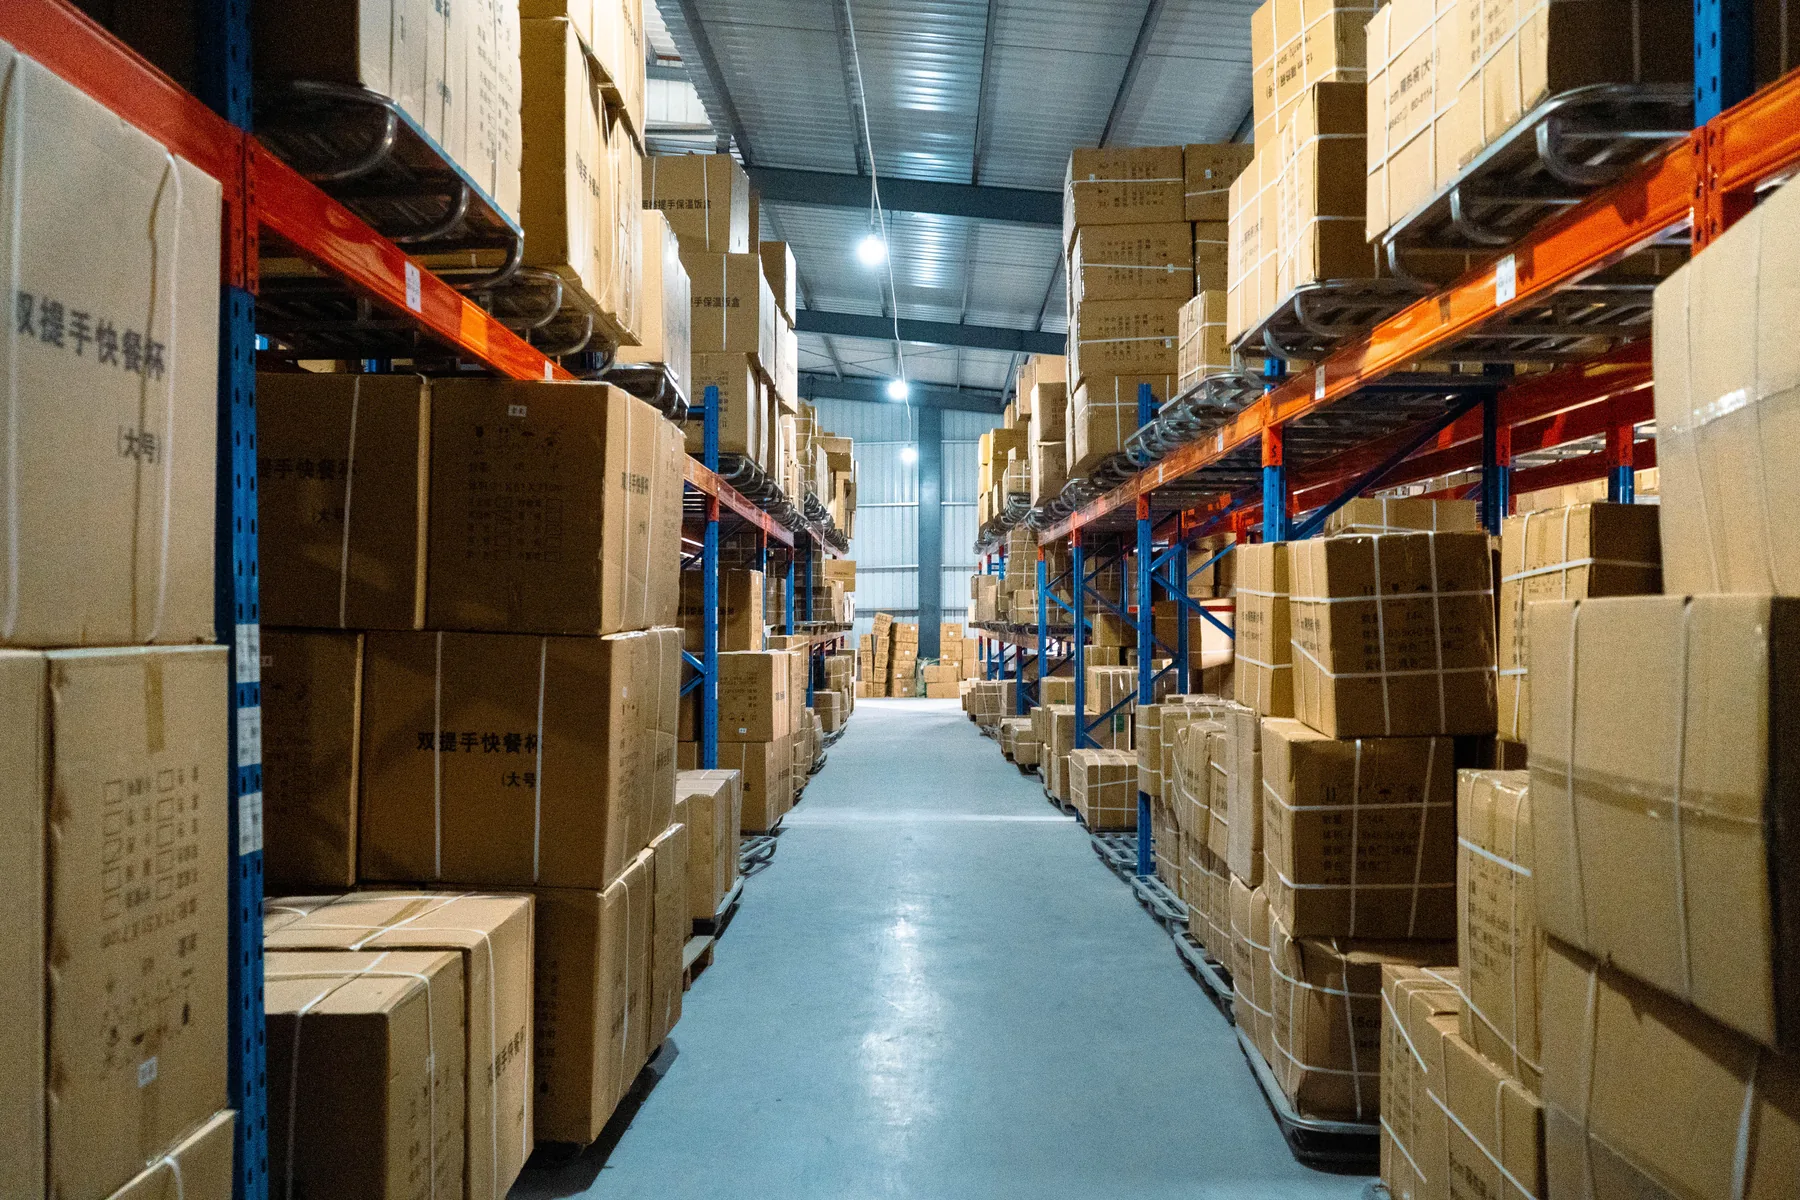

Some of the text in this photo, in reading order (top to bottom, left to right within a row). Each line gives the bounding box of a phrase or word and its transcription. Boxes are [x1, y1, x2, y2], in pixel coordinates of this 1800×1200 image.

[691, 296, 740, 309] 手保温饭盒
[417, 732, 543, 753] 双提手快餐杯
